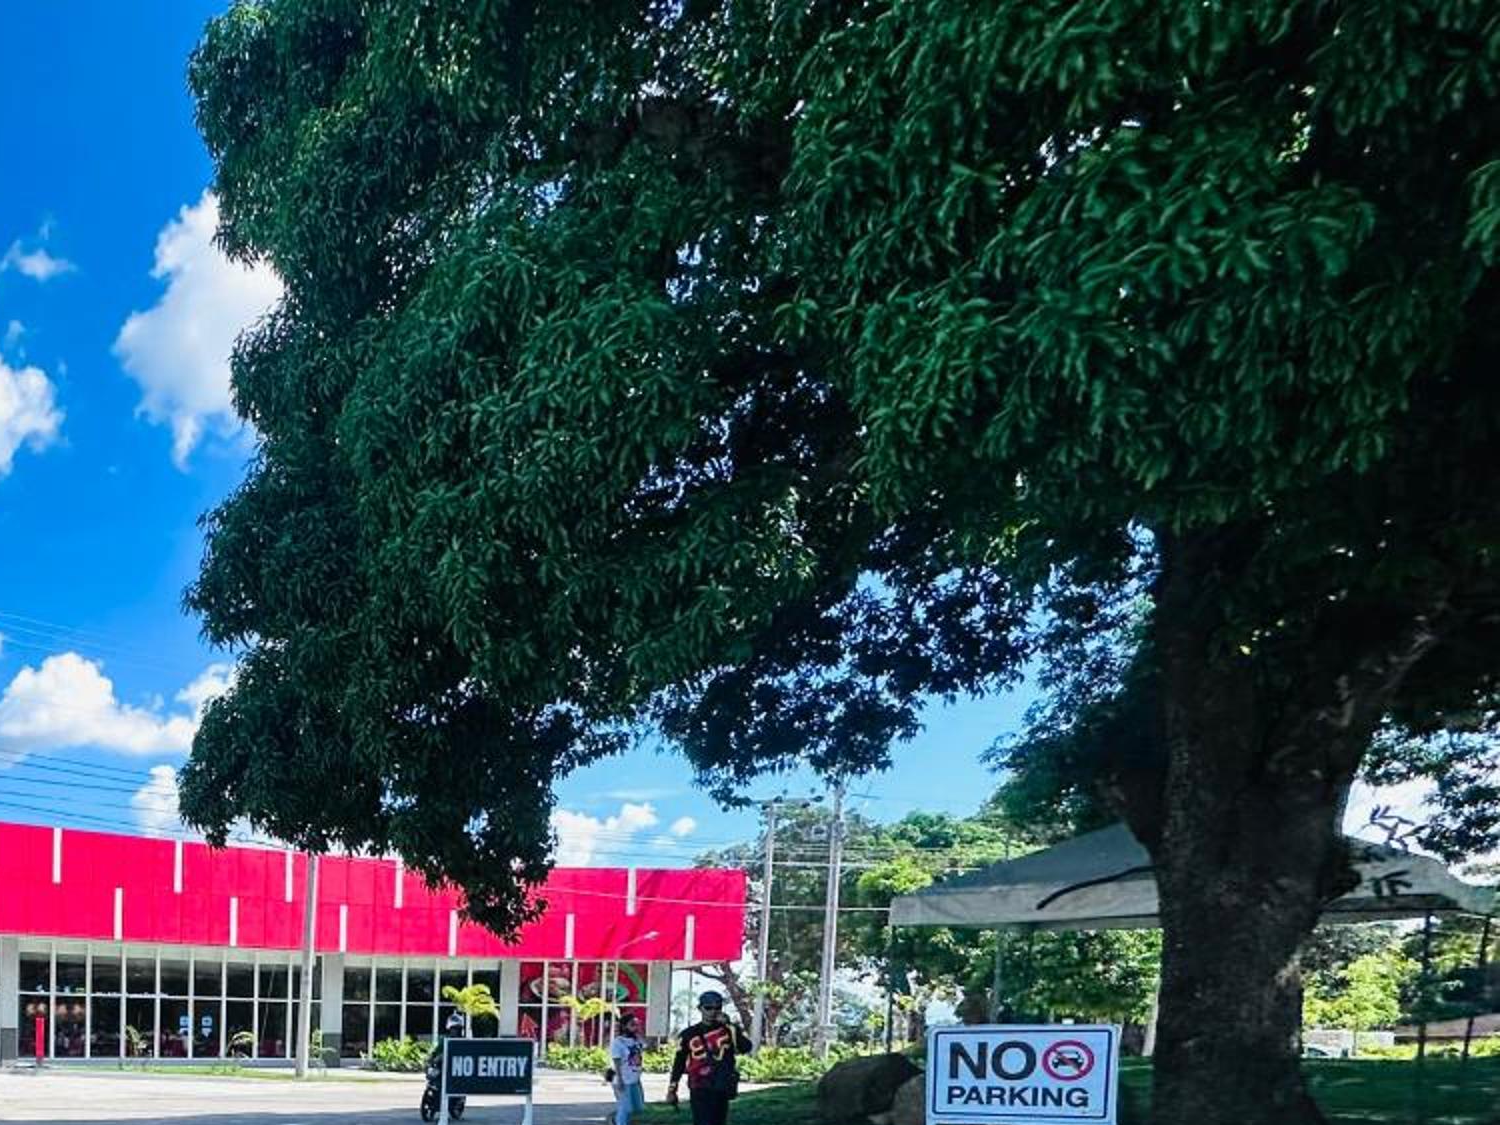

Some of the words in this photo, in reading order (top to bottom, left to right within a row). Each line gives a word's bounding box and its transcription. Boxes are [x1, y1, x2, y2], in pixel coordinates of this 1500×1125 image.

[451, 1056, 474, 1077] NO
[477, 1056, 529, 1077] ENTRY
[949, 1041, 1037, 1081] NO
[946, 1085, 1090, 1108] PARKING
